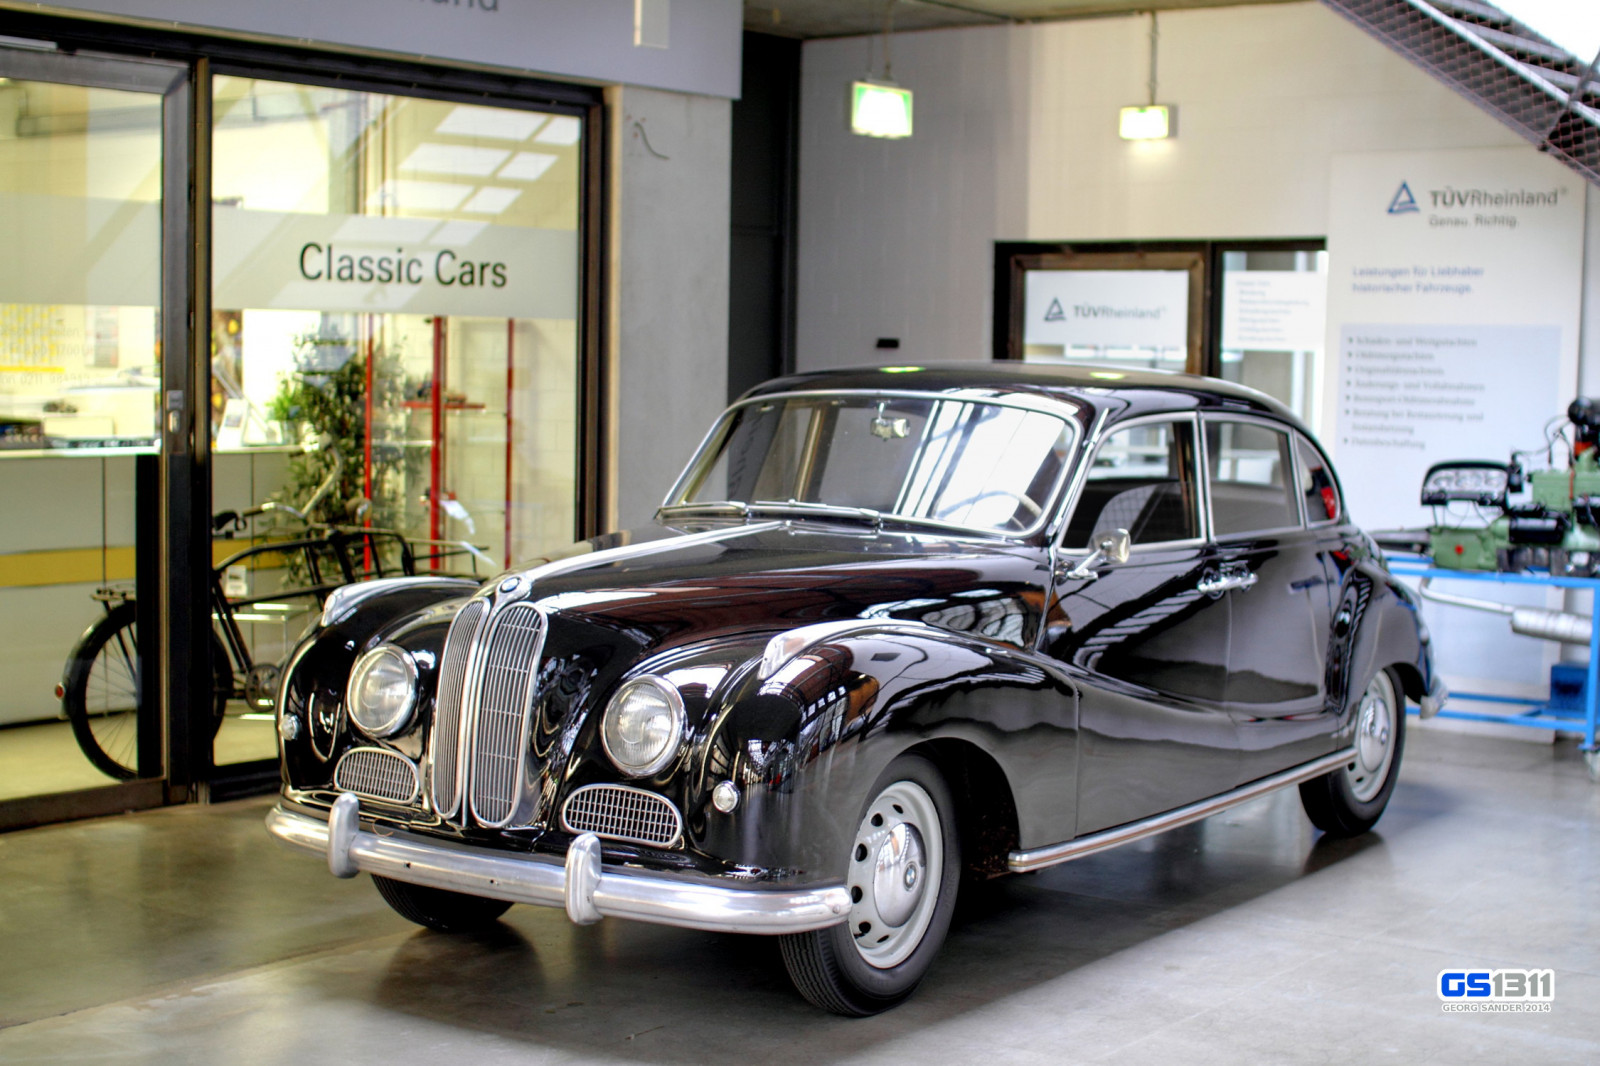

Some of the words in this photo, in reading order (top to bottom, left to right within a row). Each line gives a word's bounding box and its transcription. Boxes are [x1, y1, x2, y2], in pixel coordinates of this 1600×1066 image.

[299, 242, 423, 285] Classic
[434, 248, 508, 289] Cars
[1352, 266, 1410, 280] Leistungen
[1430, 266, 1484, 277] Liebhaber
